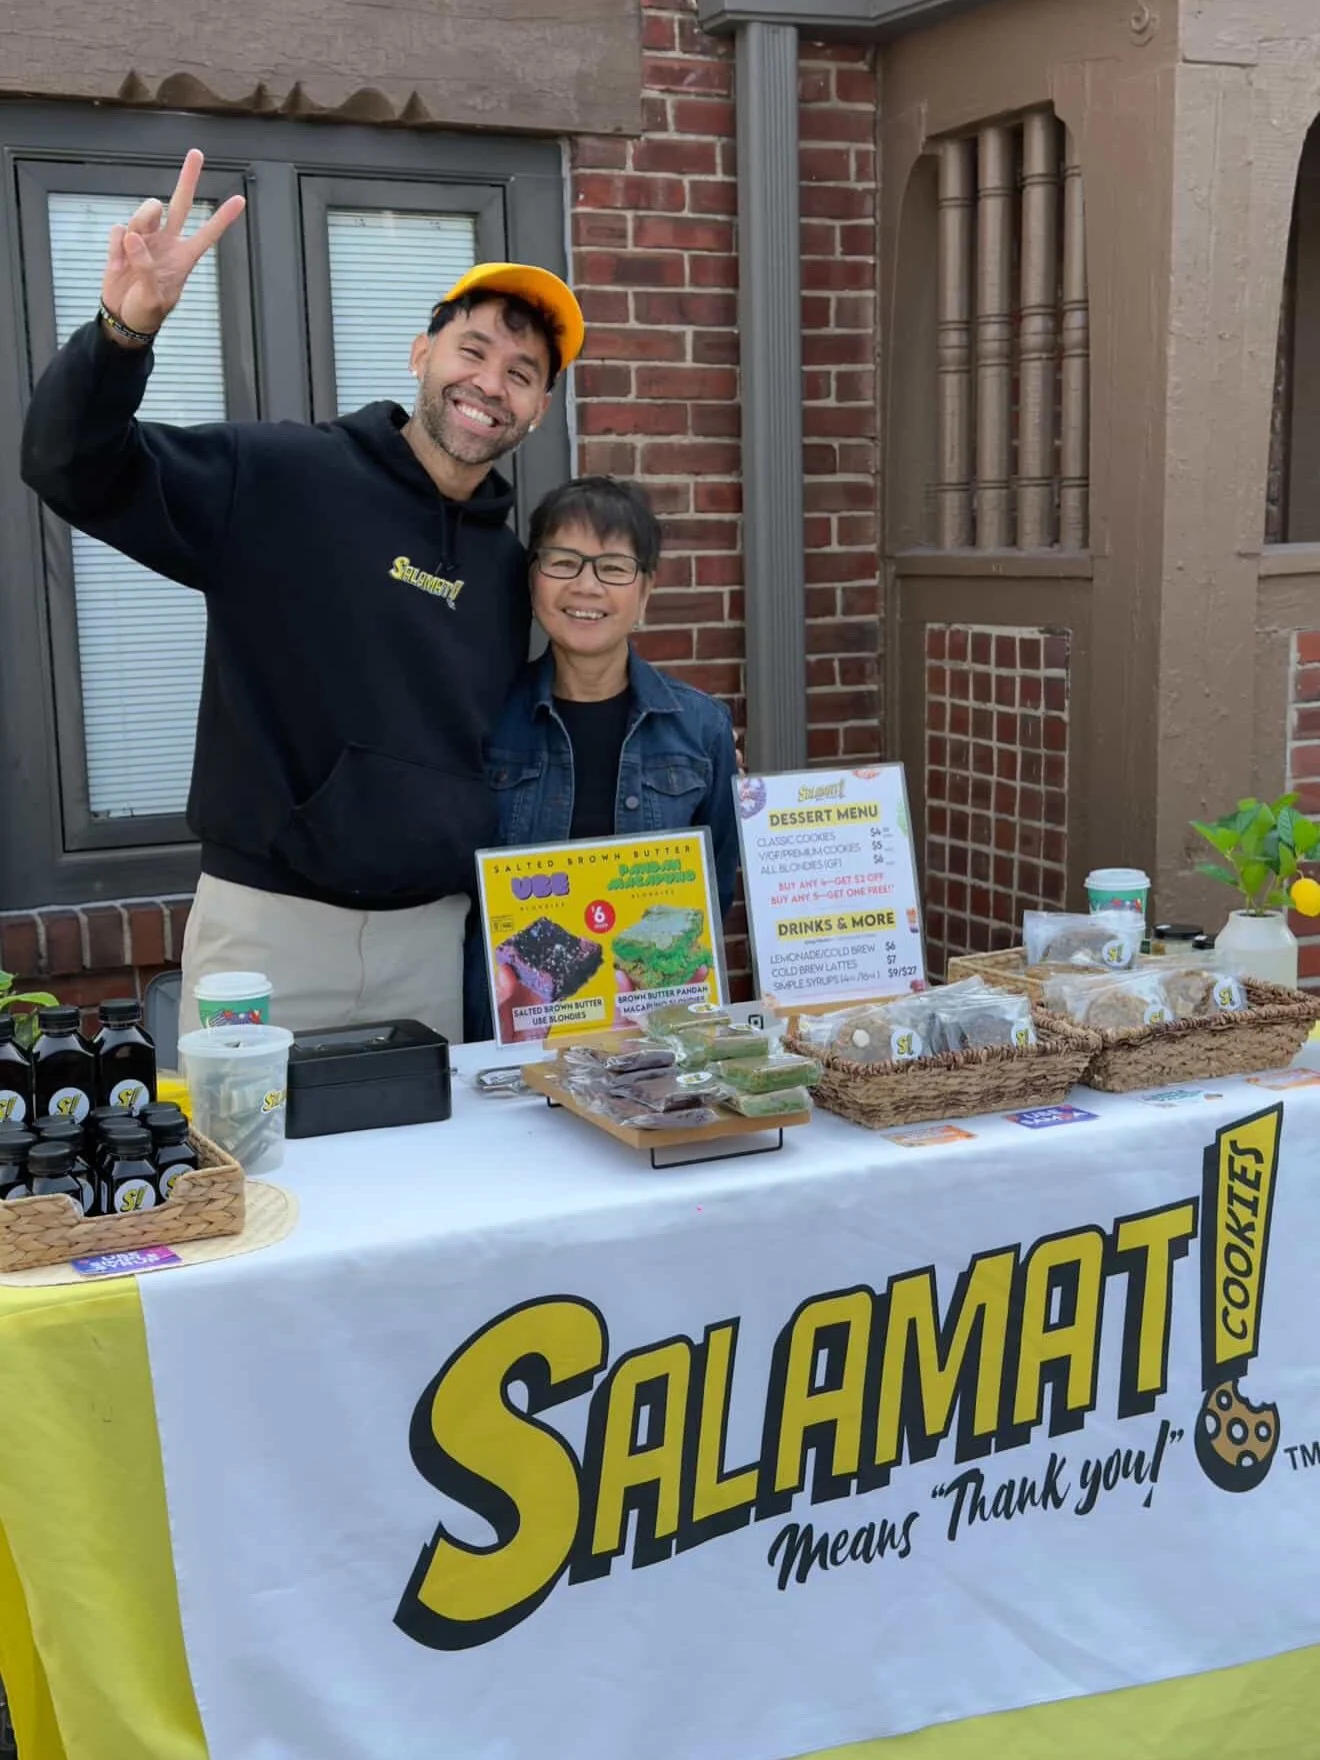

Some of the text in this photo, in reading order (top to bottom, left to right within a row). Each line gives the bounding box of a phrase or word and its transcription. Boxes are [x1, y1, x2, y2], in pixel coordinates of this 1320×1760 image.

[769, 804, 878, 827] DESSERT MENU
[757, 831, 836, 847] CLASSIC COOKIES
[824, 842, 861, 854] COOKIES
[494, 845, 690, 874] SALTED BROWN BUTTER
[760, 865, 777, 875] ALL
[511, 871, 570, 900] UBE
[778, 882, 796, 891] BUY
[799, 879, 818, 889] ANY
[867, 872, 884, 882] OFF
[771, 895, 788, 905] BUY
[791, 893, 810, 904] ANY
[846, 886, 865, 897] ONE
[778, 912, 895, 936] DRINKS & MORE
[850, 944, 876, 954] BREW
[886, 954, 896, 965] $7
[771, 960, 857, 978] COLD BREW LATTES
[888, 966, 917, 979] $9/$27
[774, 980, 805, 991] SIMPLE
[805, 976, 839, 988] SYRUPS
[617, 986, 708, 1004] BROWN BUTTER PANDAN
[513, 998, 602, 1018] SALTED BROWN BUTTER
[549, 1011, 587, 1025] BLONDIES
[1221, 1139, 1264, 1341] COOKIES
[1284, 1441, 1320, 1471] TM
[767, 1511, 920, 1591] Means
[931, 1452, 1071, 1542] “Thank
